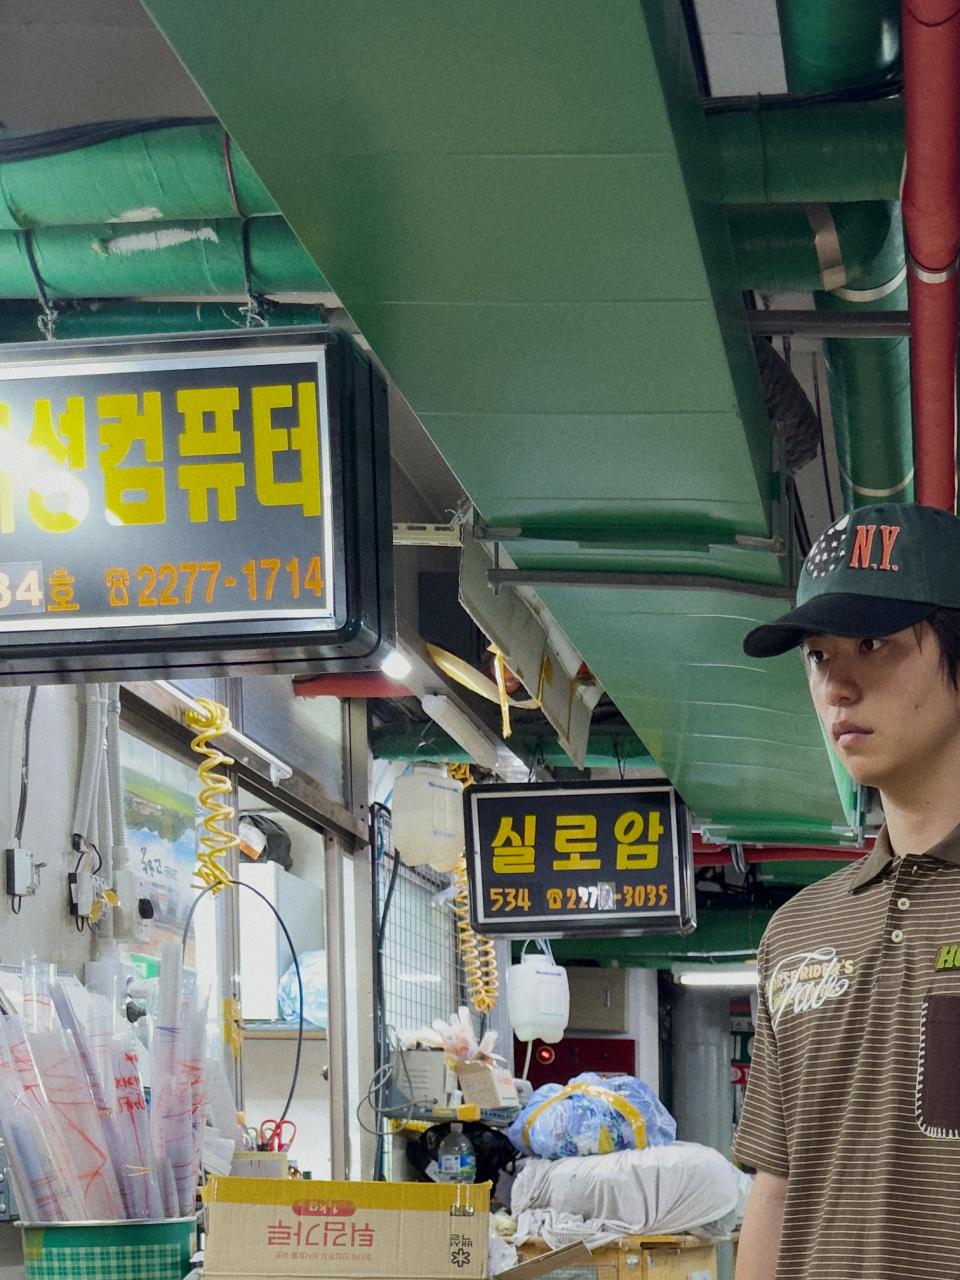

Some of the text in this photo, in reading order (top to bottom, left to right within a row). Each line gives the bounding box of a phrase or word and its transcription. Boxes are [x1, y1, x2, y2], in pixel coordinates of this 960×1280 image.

[0, 382, 321, 534] 성컴퓨터
[137, 556, 325, 607] 2277-1714
[490, 811, 664, 874] 실로암
[490, 888, 531, 912] 534
[266, 1220, 376, 1248] 튀김가루
